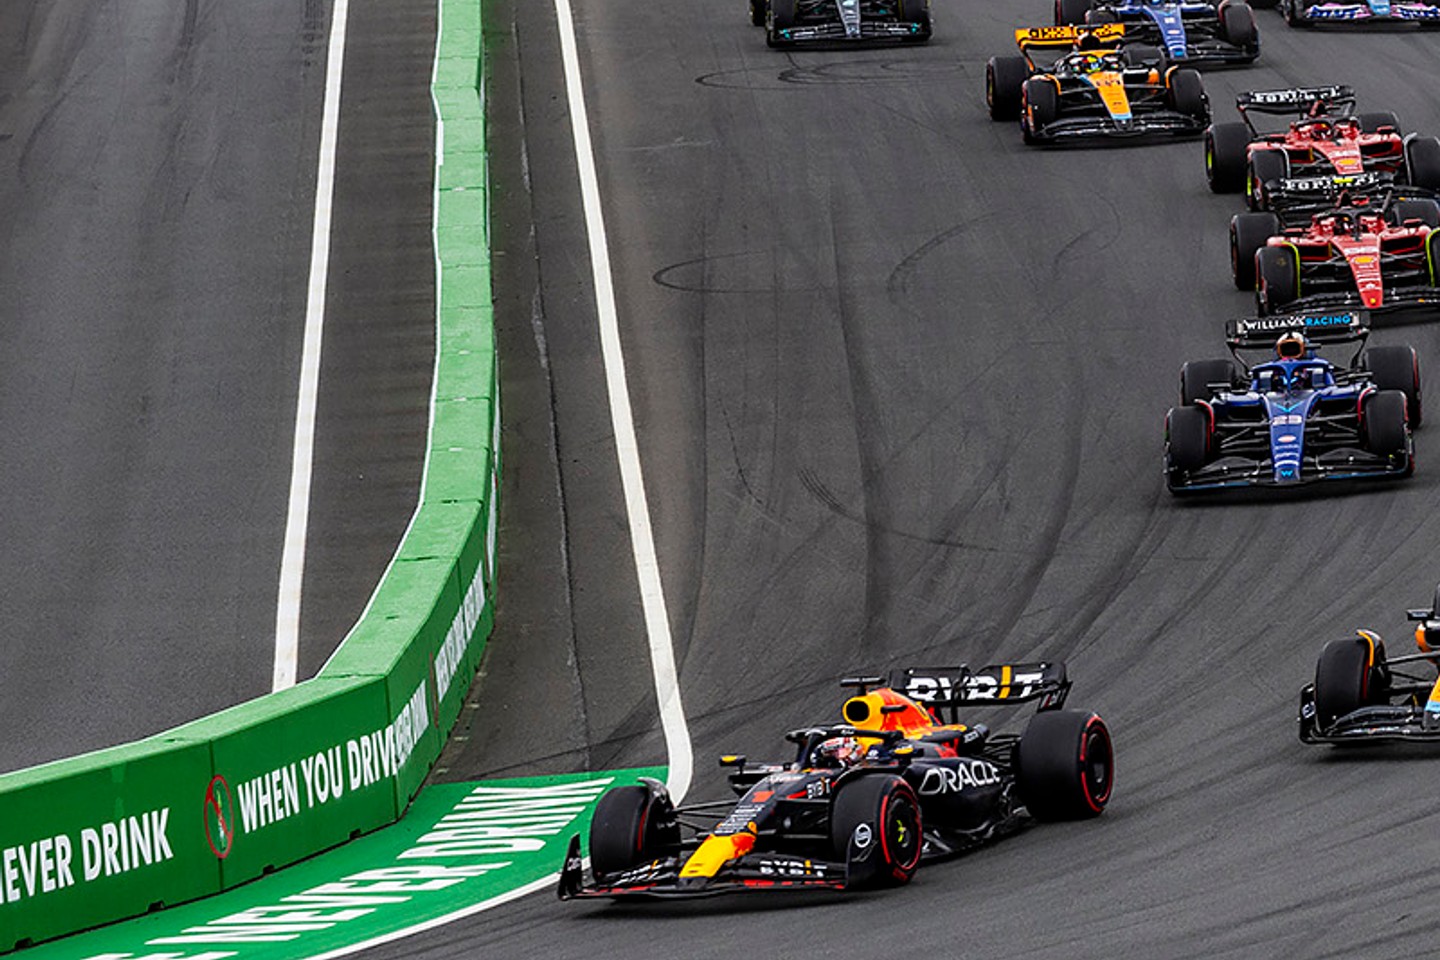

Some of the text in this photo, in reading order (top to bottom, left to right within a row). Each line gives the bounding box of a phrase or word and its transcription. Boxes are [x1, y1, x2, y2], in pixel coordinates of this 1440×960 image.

[1305, 314, 1351, 327] RACING
[236, 764, 301, 834] WHEN
[301, 746, 343, 809] YOU
[346, 724, 398, 790] DRIV
[917, 760, 1001, 795] ORACLE
[0, 808, 174, 905] EVER DRINK
